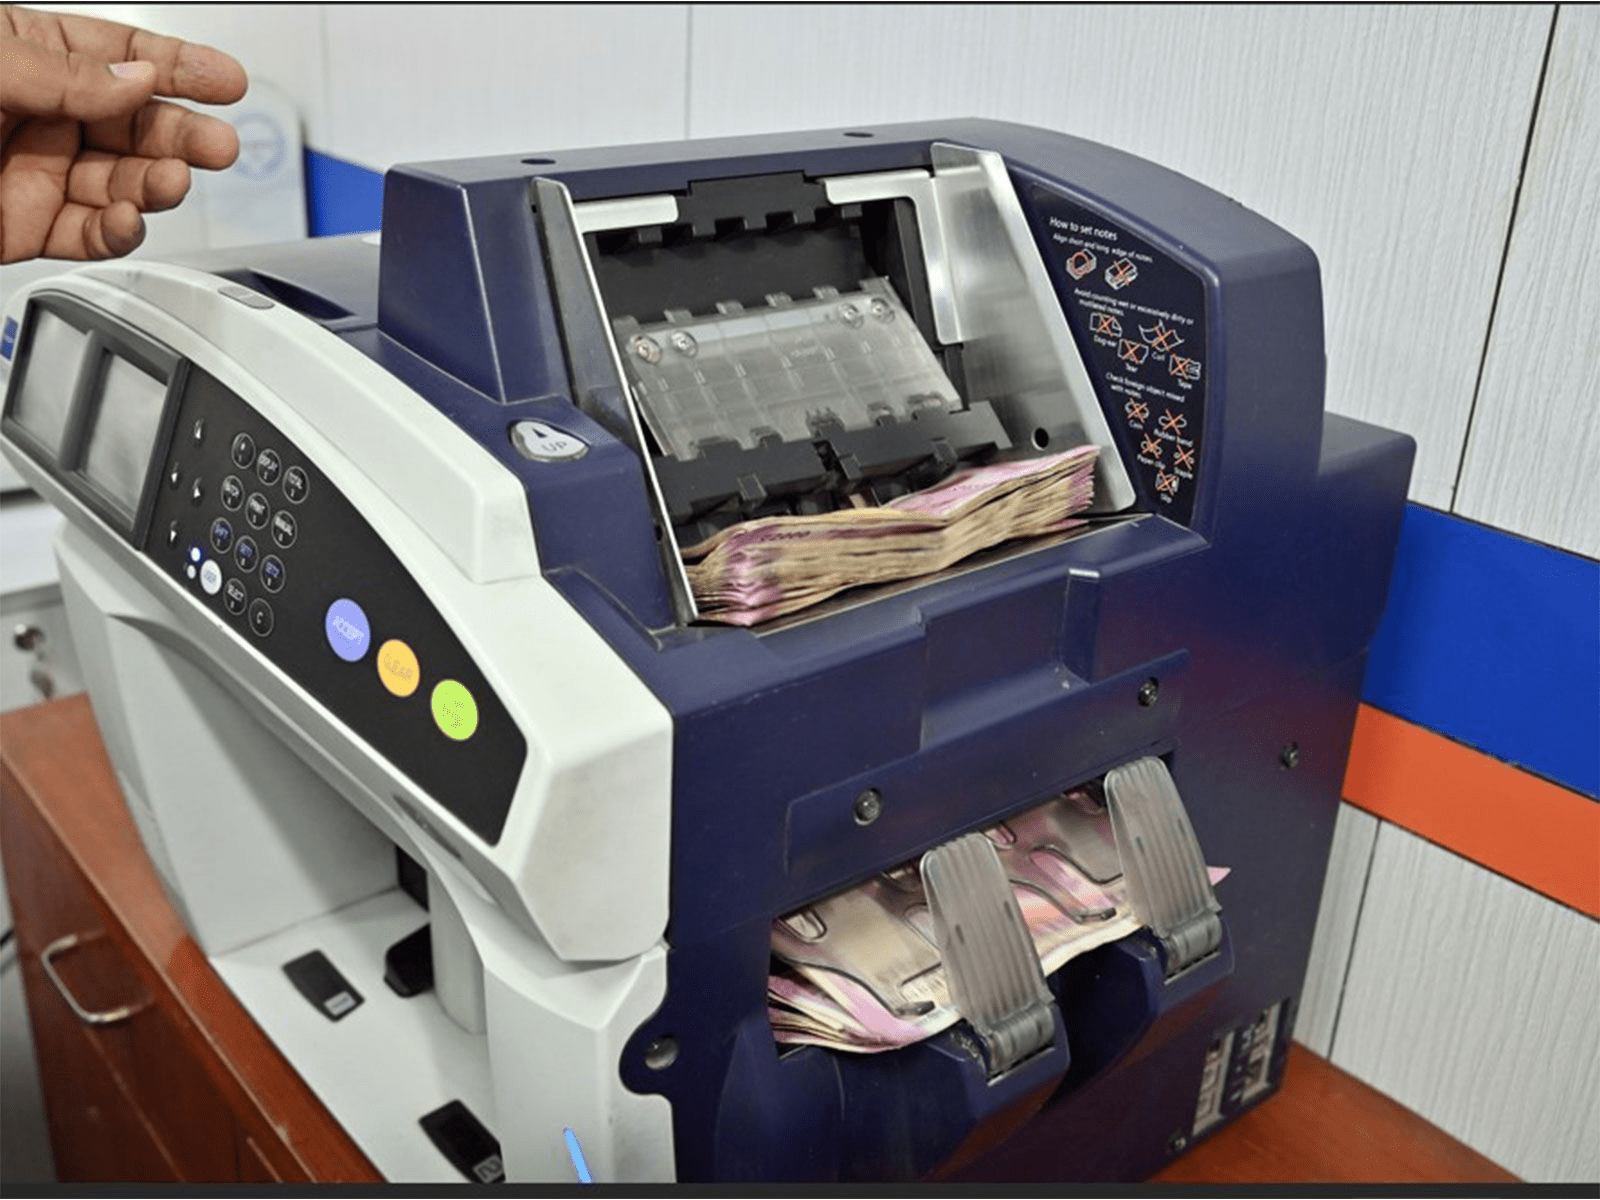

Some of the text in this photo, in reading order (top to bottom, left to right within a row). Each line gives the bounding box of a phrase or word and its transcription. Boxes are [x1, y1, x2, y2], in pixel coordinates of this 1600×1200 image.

[1049, 216, 1117, 241] How to set notes
[1053, 232, 1067, 243] Align
[1084, 241, 1096, 250] and
[1096, 243, 1110, 254] long
[1112, 248, 1127, 257] edge
[1128, 250, 1135, 258] of
[1074, 287, 1091, 298] Avoid
[1091, 293, 1117, 307] counting
[1118, 300, 1129, 308] wet
[1137, 305, 1170, 320] excessively
[1171, 313, 1186, 325] dirty
[1094, 334, 1117, 347] Dog-ear
[1151, 351, 1165, 361] Curl
[1105, 372, 1185, 403] Check foreign object mixed
[1110, 384, 1124, 392] with
[1178, 378, 1192, 389] Tape
[1128, 419, 1143, 430] Coin
[1153, 427, 1193, 448] Rubber band
[541, 440, 568, 452] UP
[256, 611, 263, 624] C
